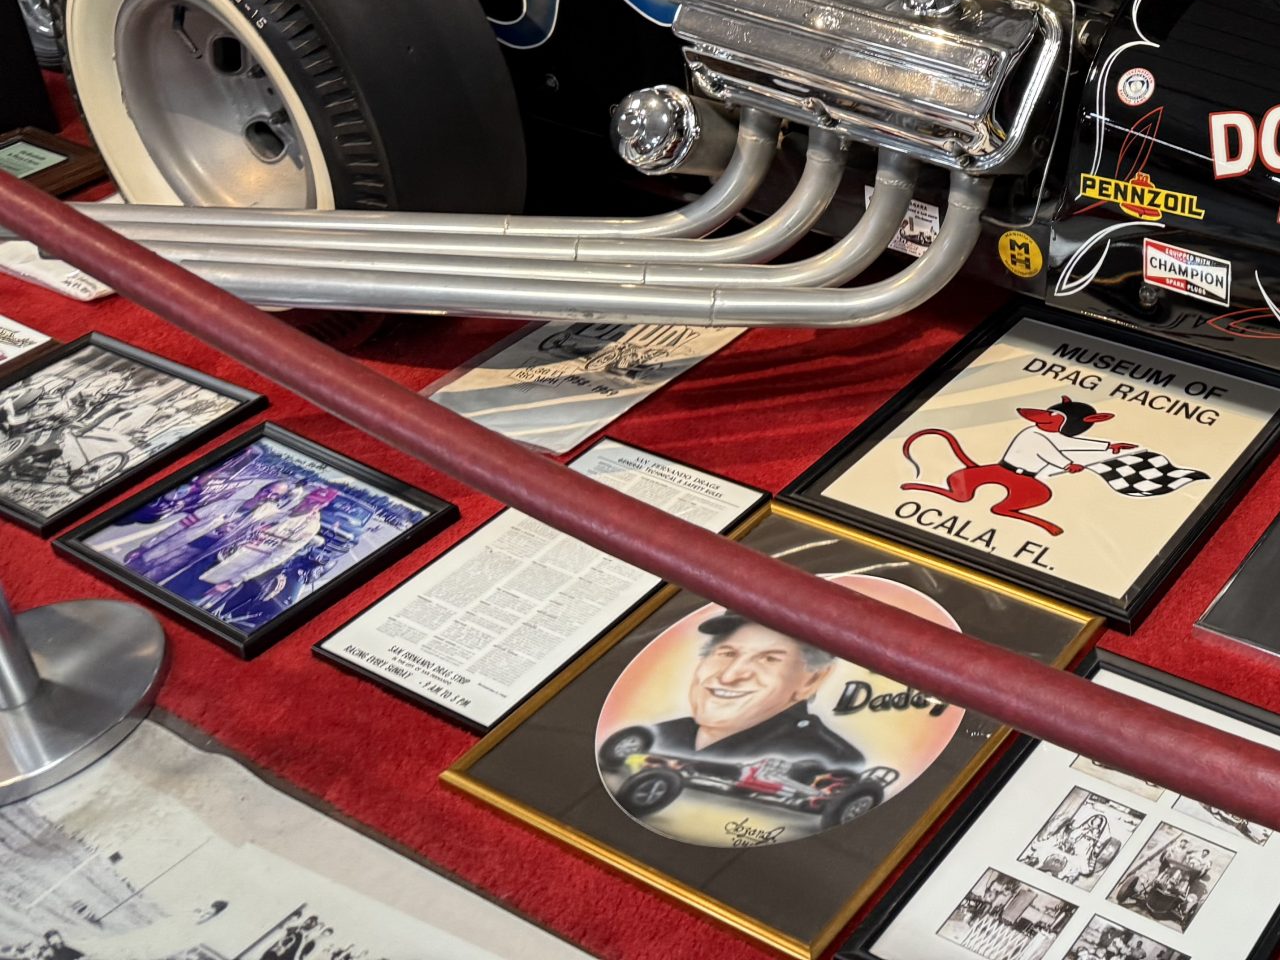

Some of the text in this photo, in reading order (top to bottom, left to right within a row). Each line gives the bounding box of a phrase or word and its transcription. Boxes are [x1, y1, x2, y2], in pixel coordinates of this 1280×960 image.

[1081, 175, 1206, 218] PENNZOIL
[1009, 239, 1030, 255] M
[1010, 253, 1031, 270] H
[1165, 247, 1212, 266] EQUIPPED WITH
[1149, 256, 1224, 289] CHAMPION
[1165, 278, 1206, 295] SPARK PLUGS
[1052, 343, 1229, 401] MUSEUM OF
[1022, 358, 1221, 427] DRAG RACING
[617, 458, 643, 470] GENERAL
[645, 467, 676, 483] TECHNICAL
[683, 480, 705, 493] SAFETY
[651, 462, 692, 480] FERNANDO
[694, 476, 721, 490] DRAGS
[894, 501, 1056, 572] OCALA, FL.
[343, 645, 369, 659] RACING
[366, 655, 386, 669] EVERY
[385, 665, 413, 679] SUNDAY
[430, 684, 443, 693] AM
[442, 689, 452, 698] TO
[456, 697, 471, 707] PM
[388, 645, 471, 685] SAN FERNANDO DRAG STRIP
